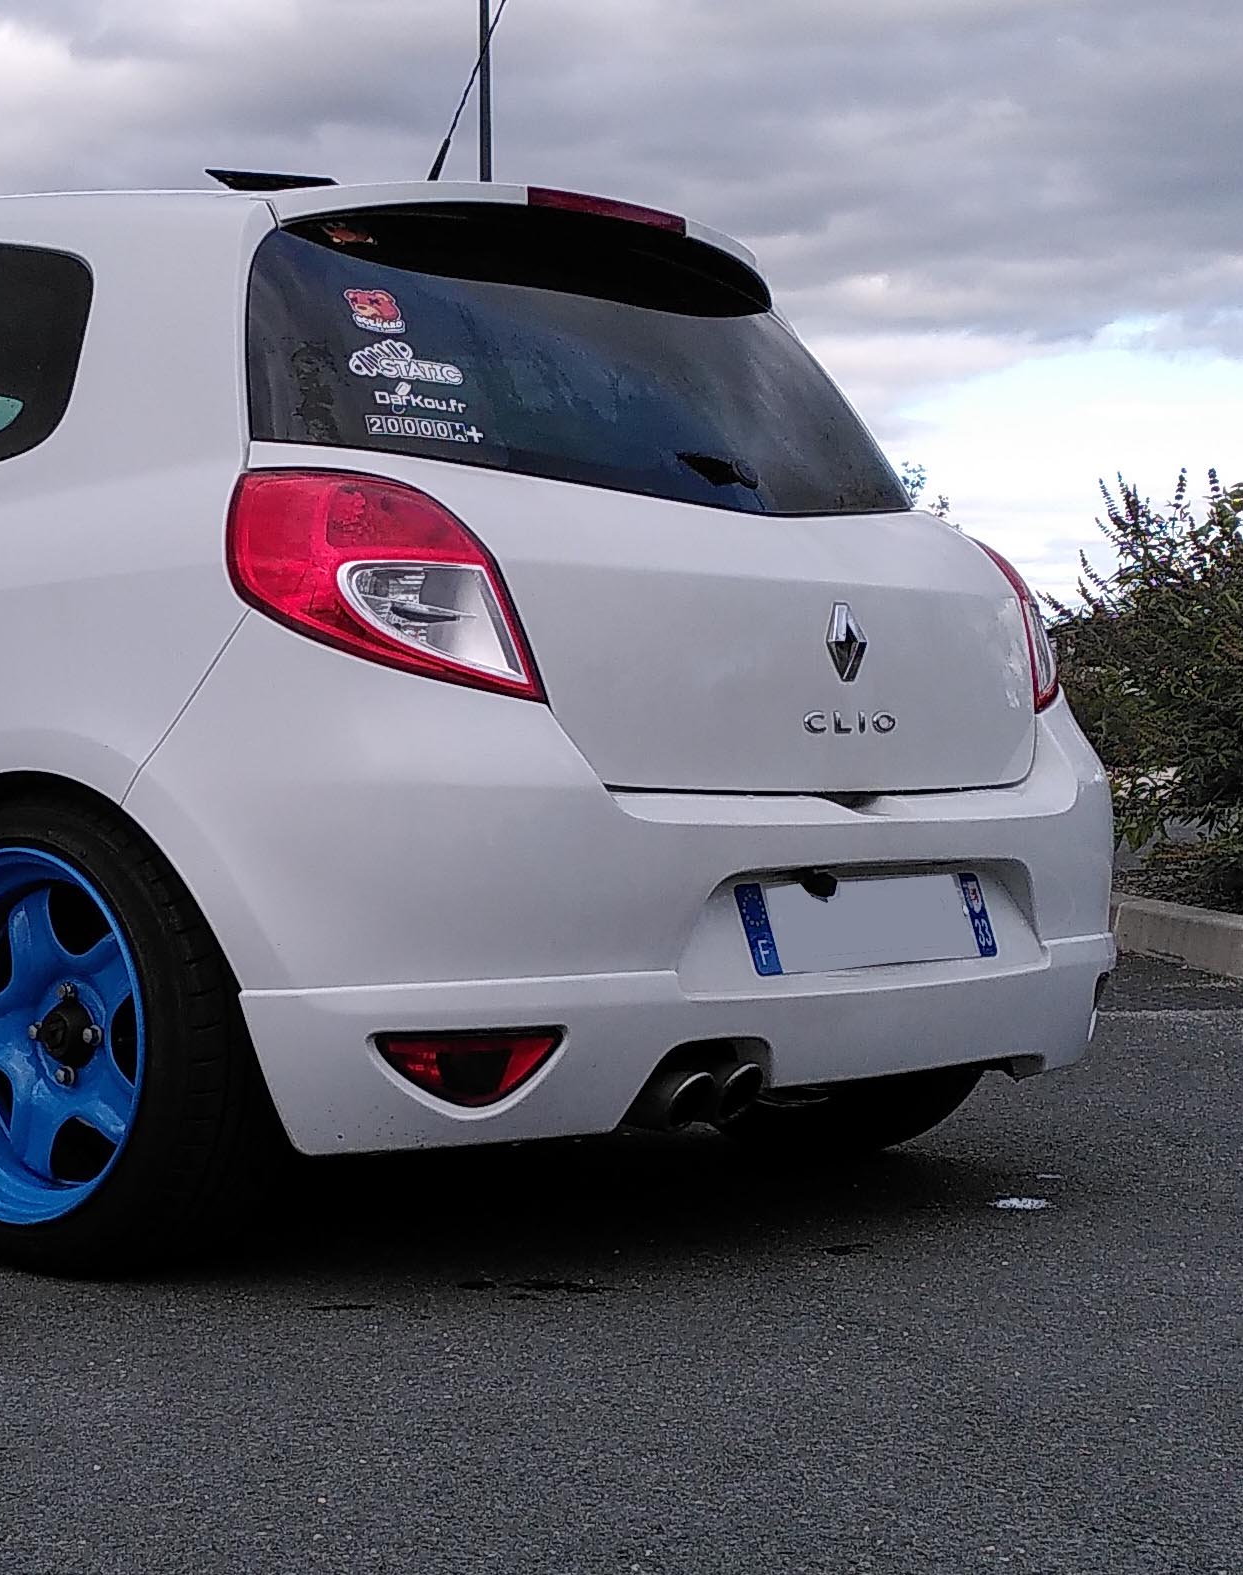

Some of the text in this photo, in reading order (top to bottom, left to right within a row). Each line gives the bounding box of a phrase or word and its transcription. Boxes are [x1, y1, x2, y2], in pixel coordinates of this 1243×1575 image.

[379, 358, 462, 385] STATIC
[803, 710, 896, 734] CLIO
[974, 918, 993, 947] 33
[757, 939, 770, 966] F
